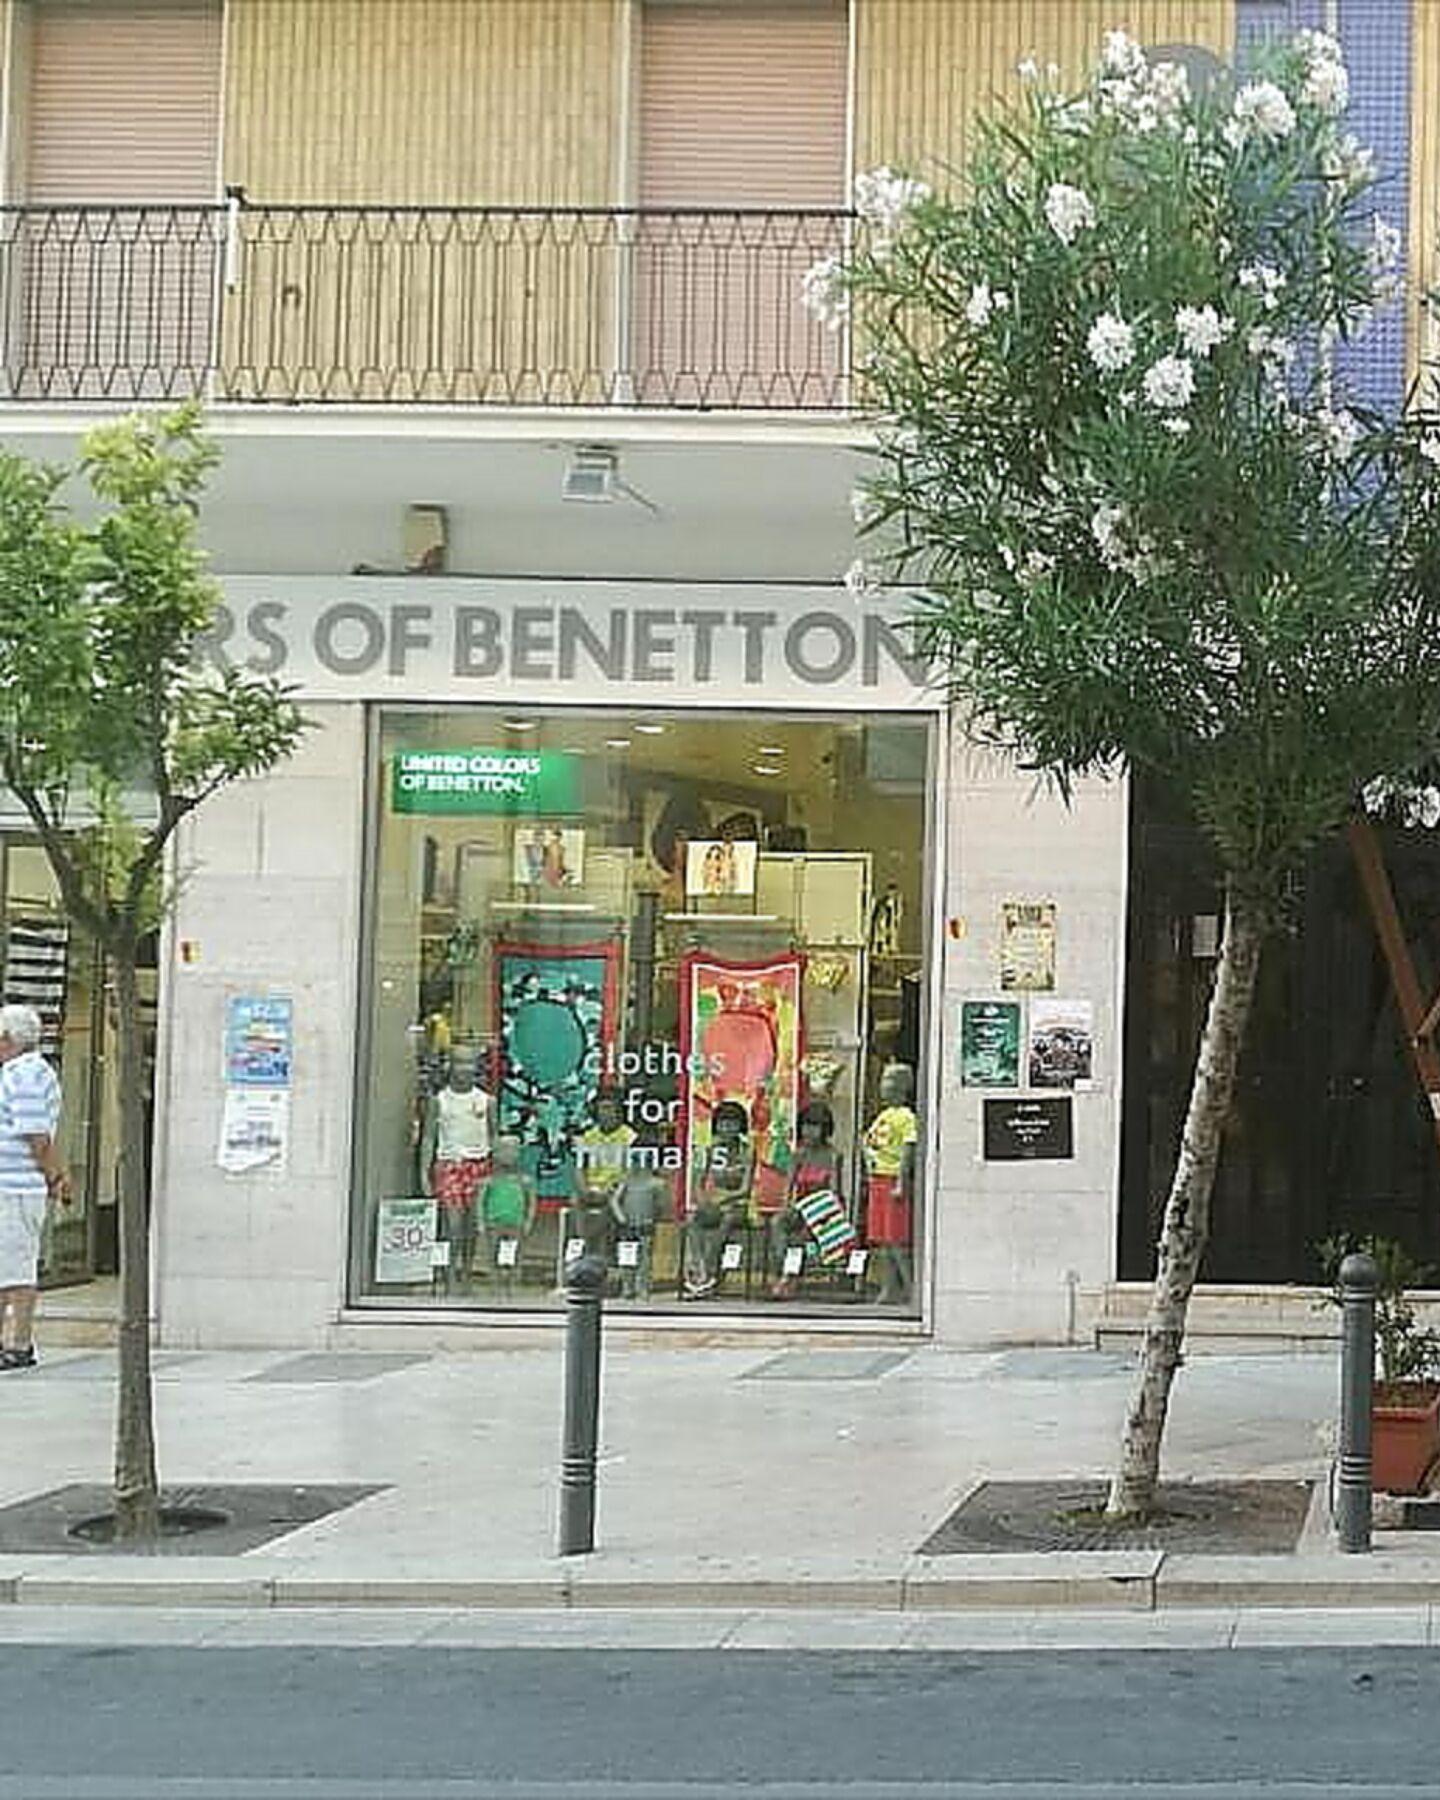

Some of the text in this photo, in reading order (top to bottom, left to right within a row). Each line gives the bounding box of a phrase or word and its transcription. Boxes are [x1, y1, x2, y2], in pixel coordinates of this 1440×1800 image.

[313, 601, 432, 676] OF
[453, 606, 930, 687] BENETTON
[401, 755, 541, 774] UNITED COLORS
[400, 774, 425, 791] OF
[584, 1041, 725, 1074] clothes
[624, 1088, 685, 1124] for
